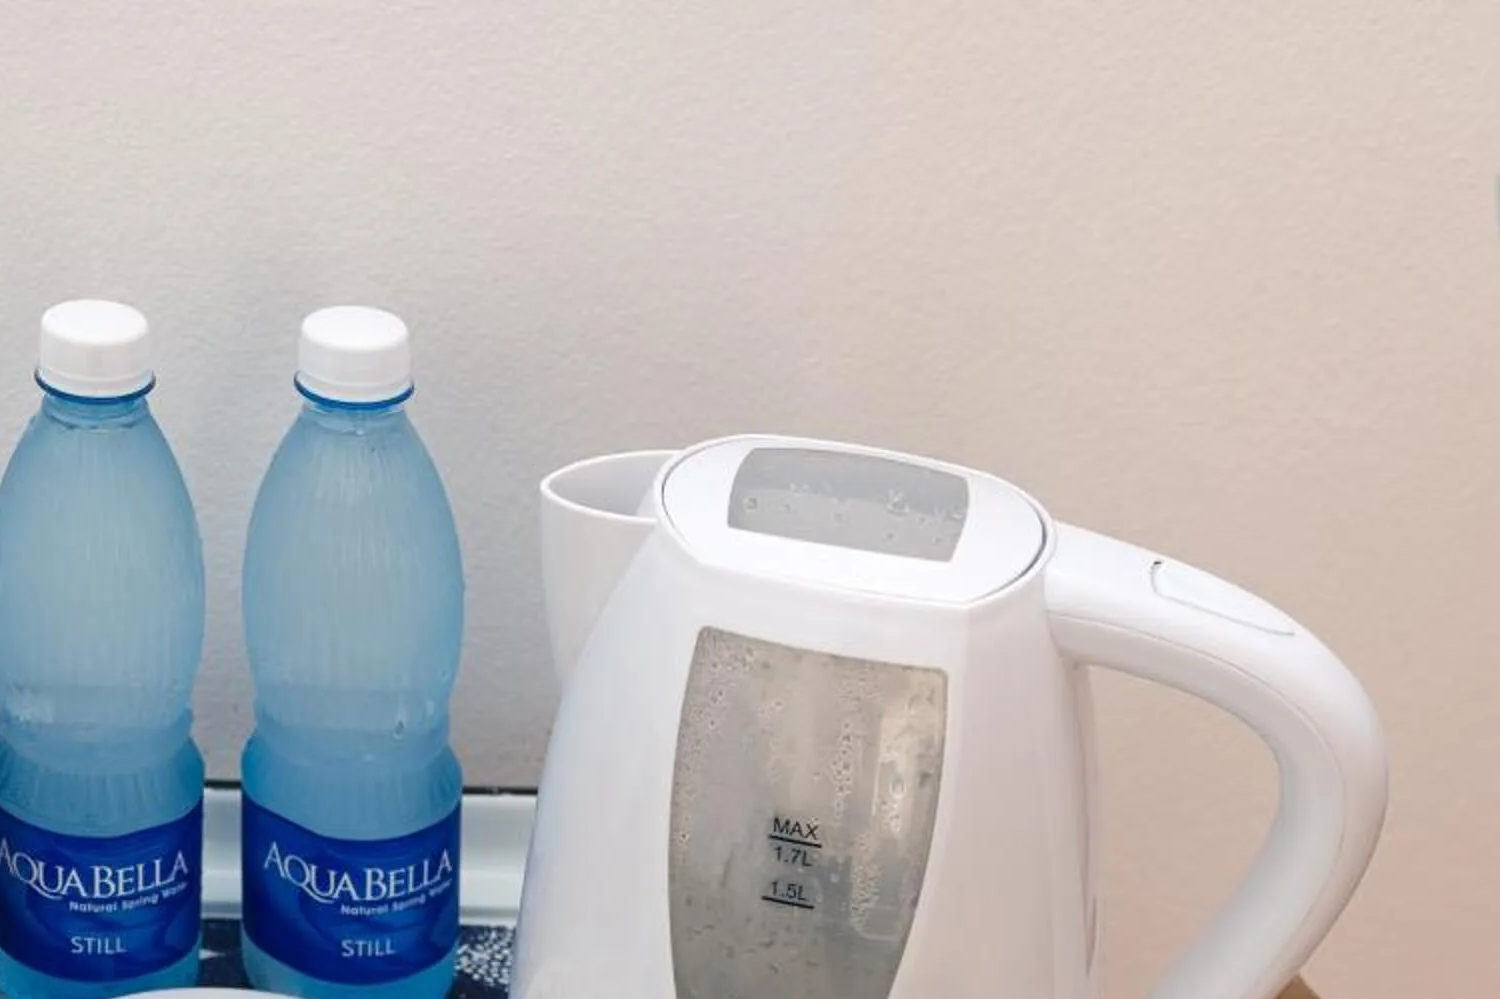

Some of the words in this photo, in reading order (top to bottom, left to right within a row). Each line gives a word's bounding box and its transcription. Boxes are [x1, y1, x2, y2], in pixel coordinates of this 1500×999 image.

[773, 817, 818, 840] MAX
[774, 846, 812, 867] 1.7L
[263, 841, 452, 904] AQUABELLA
[771, 881, 808, 901] 1.5L
[69, 901, 118, 913] Natural
[122, 892, 159, 910] Spring
[341, 904, 389, 916] Natural
[70, 936, 127, 954] STILL
[341, 939, 396, 957] STILL
